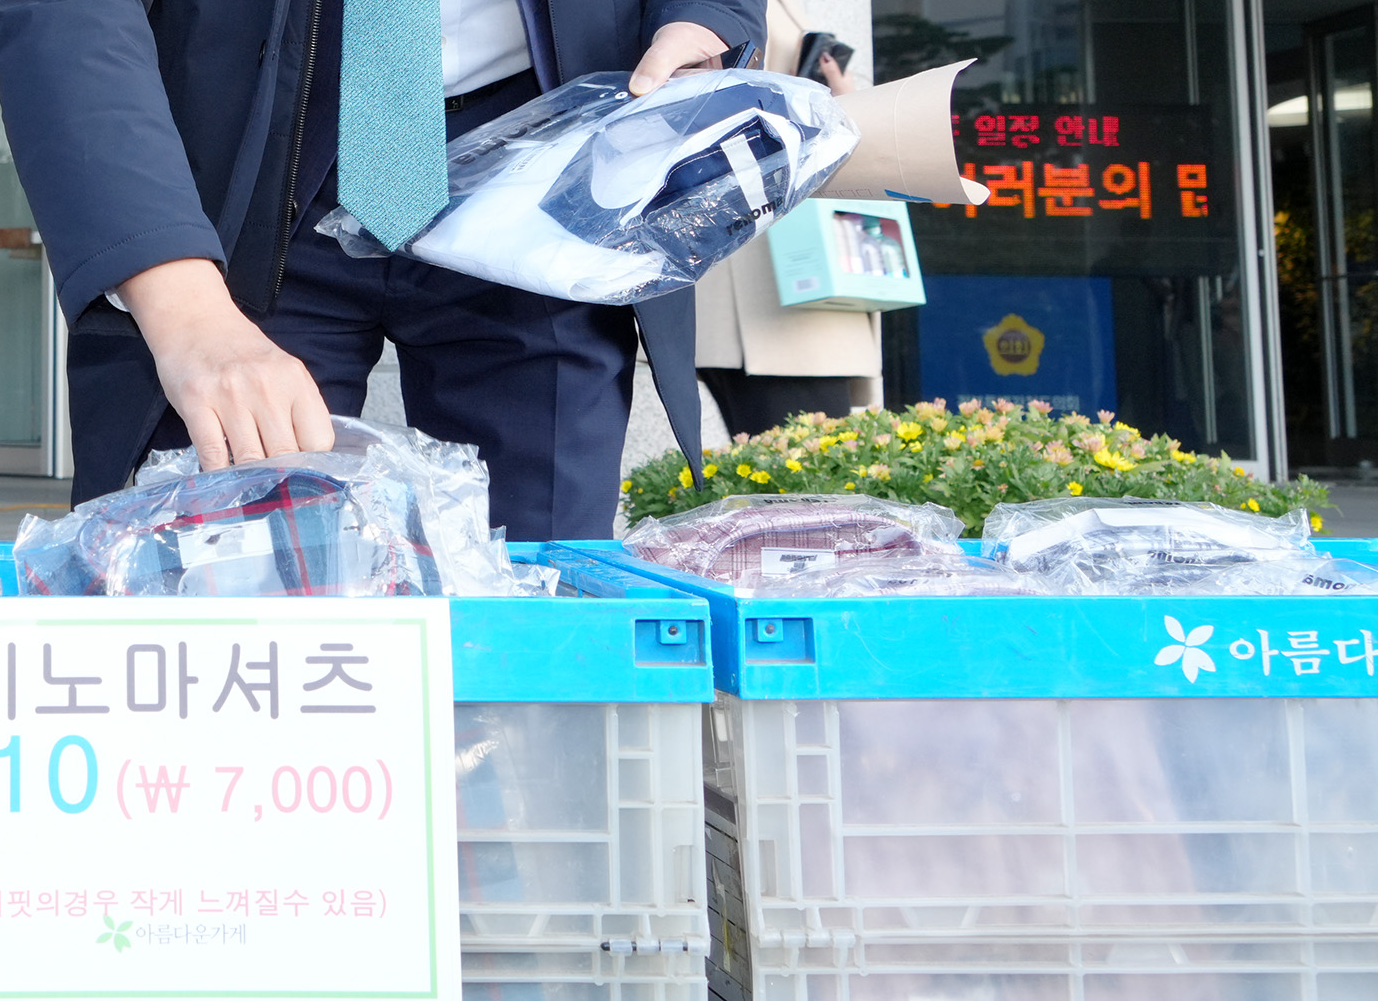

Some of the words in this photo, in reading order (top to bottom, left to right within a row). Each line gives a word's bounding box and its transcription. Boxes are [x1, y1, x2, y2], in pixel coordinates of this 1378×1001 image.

[974, 115, 1040, 148] 일정
[1054, 115, 1120, 147] 안내
[1228, 628, 1378, 677] 아름다
[214, 759, 394, 822] 7,000)
[129, 888, 184, 917] 작게
[197, 888, 311, 918] 느껴질수
[321, 888, 388, 919] 있음)
[135, 922, 247, 946] 아름다운가게
